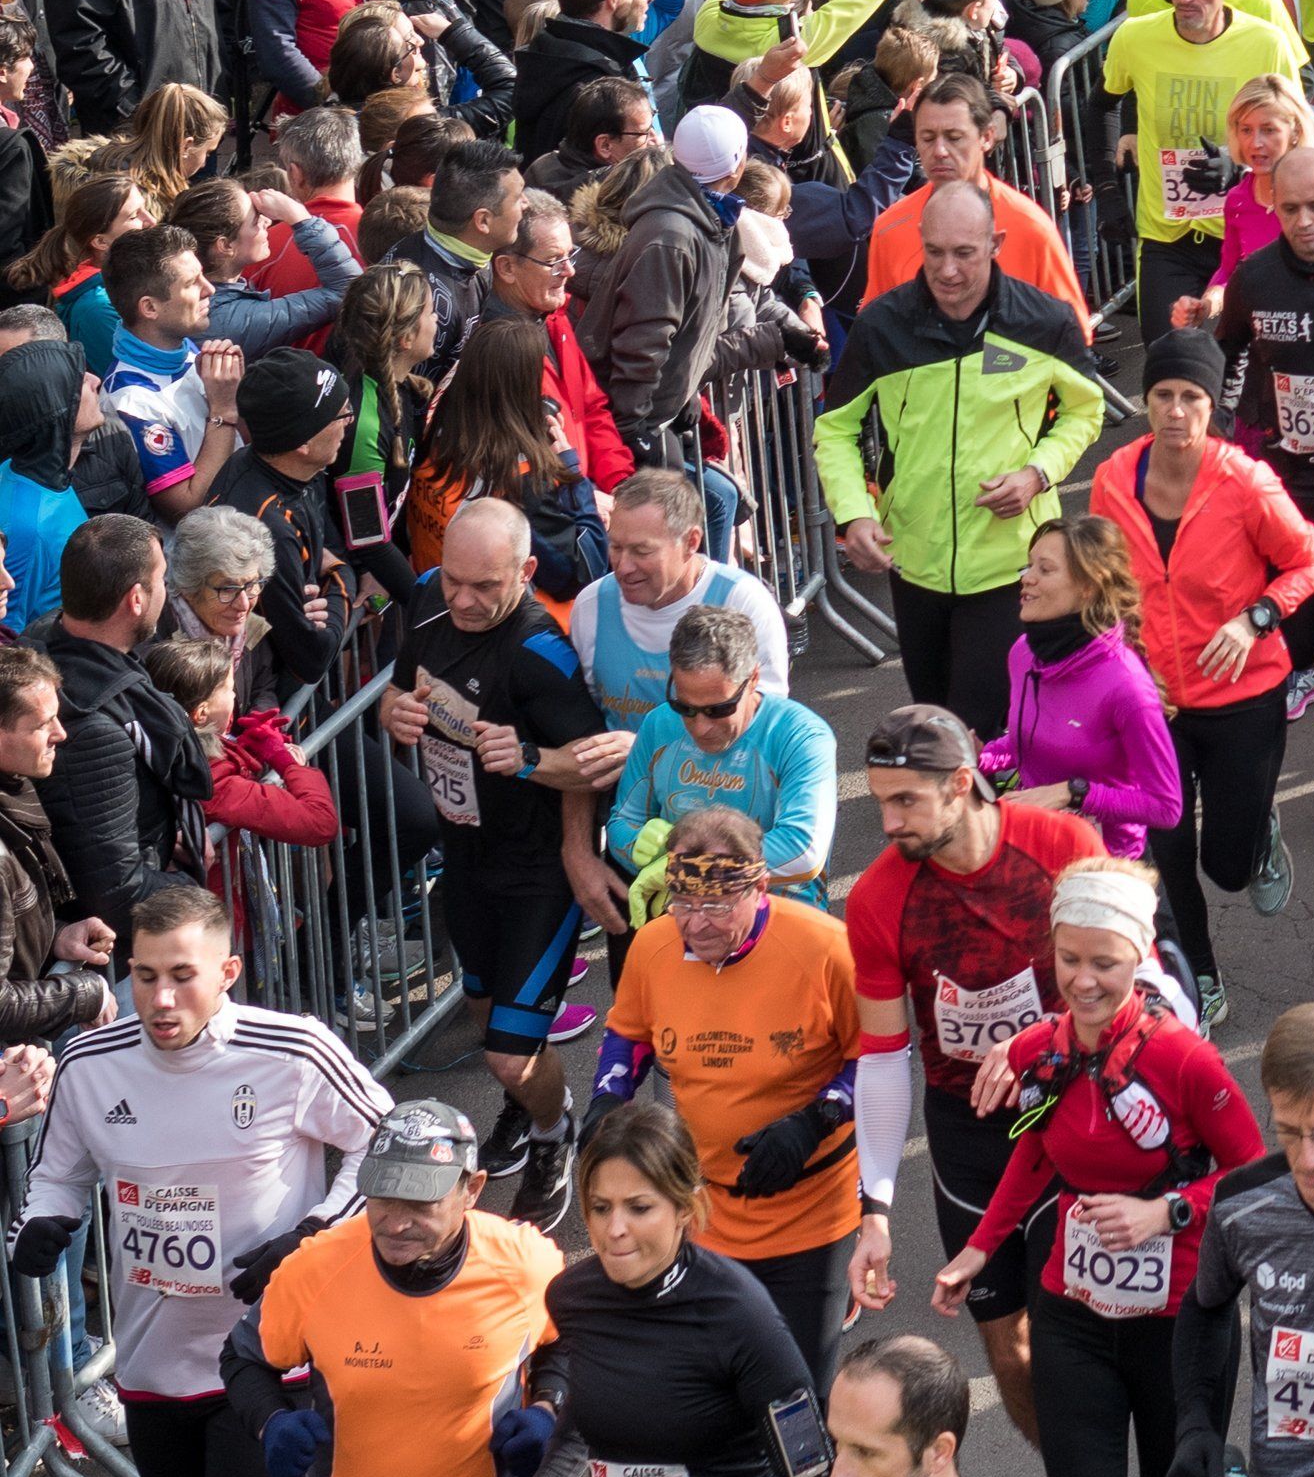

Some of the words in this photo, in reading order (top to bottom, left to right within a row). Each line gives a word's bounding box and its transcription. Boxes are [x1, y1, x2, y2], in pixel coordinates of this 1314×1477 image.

[1170, 78, 1219, 103] RUN
[977, 980, 1016, 999] CAISSE
[702, 1057, 735, 1068] LINDRY
[104, 1114, 137, 1126] adidas
[155, 1188, 199, 1199] CAISSE
[123, 1227, 215, 1271] 4760
[1068, 1244, 1164, 1293] 4023
[1280, 1273, 1306, 1292] dpd
[345, 1357, 393, 1368] MONETEAU
